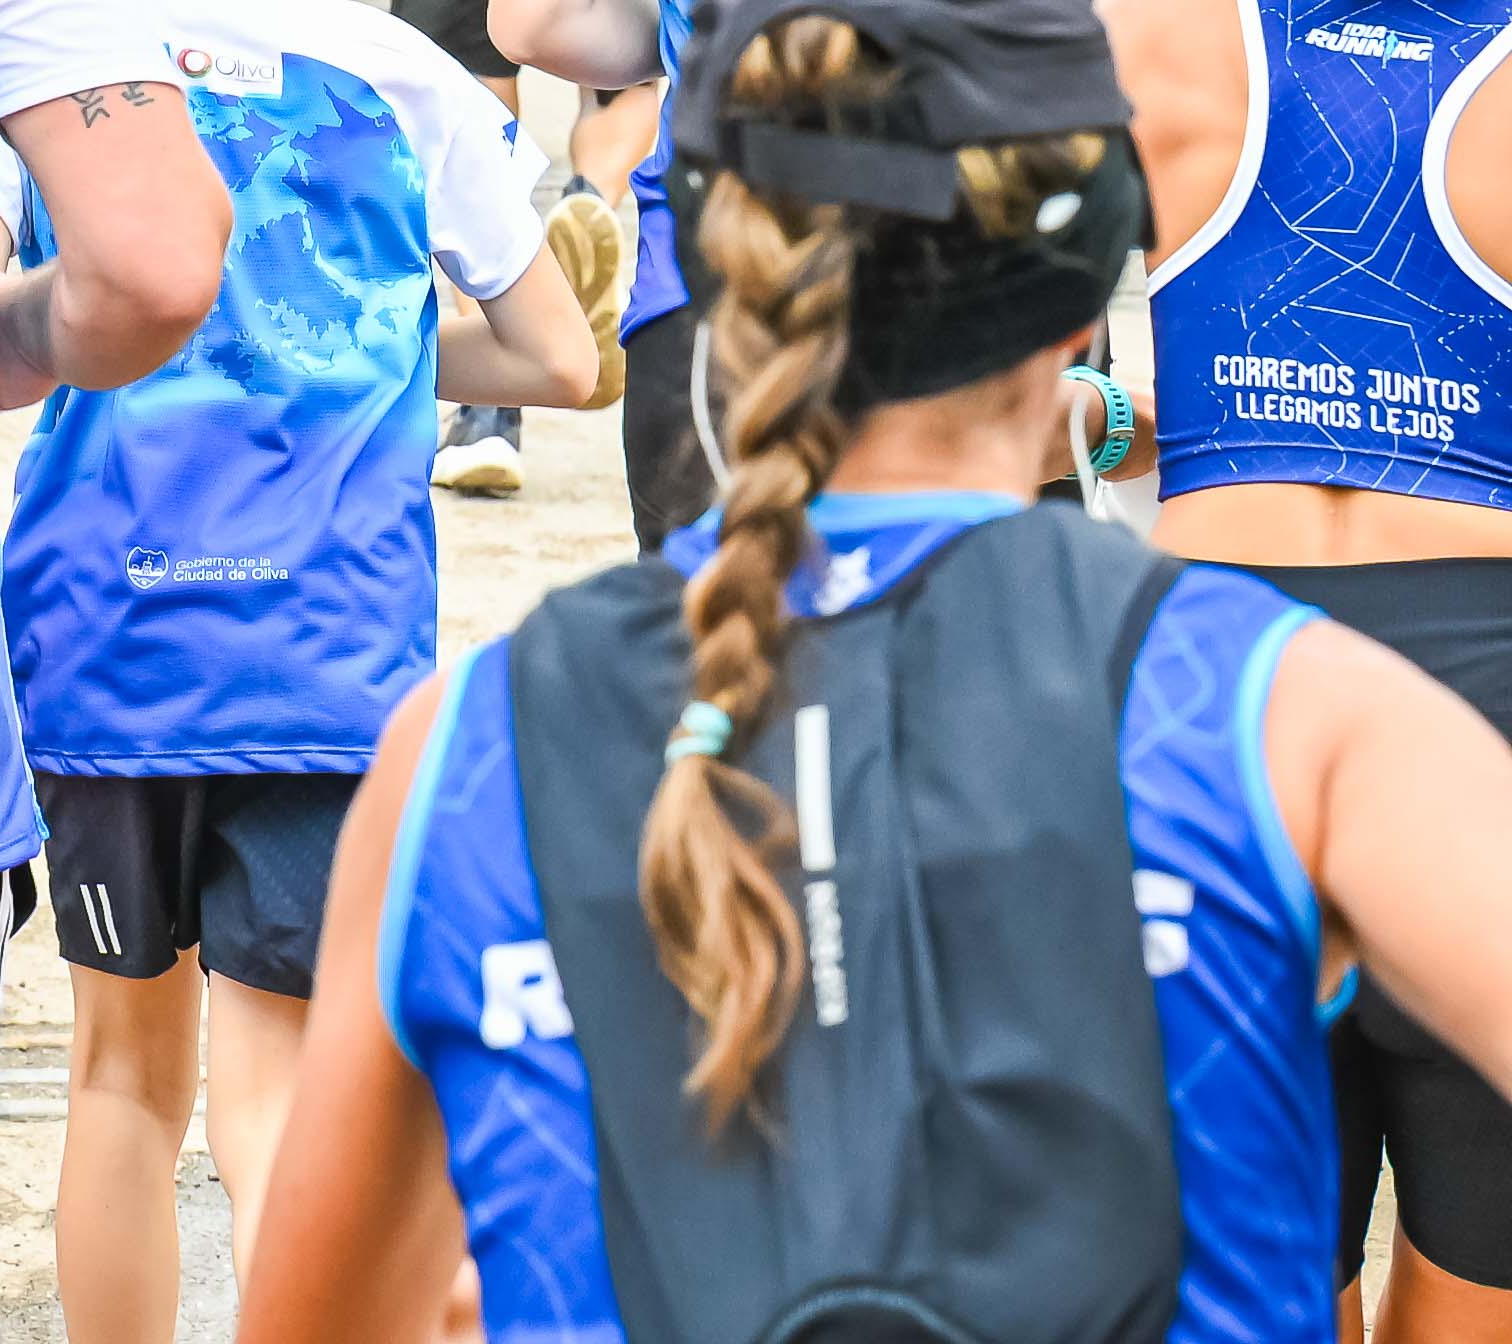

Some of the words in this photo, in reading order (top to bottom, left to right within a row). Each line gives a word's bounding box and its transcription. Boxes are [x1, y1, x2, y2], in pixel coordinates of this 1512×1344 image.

[215, 56, 275, 80] Oliva
[1213, 354, 1356, 396] CORREMOS
[1365, 368, 1481, 414] JUNTOS
[1235, 391, 1362, 430] LLEGAMOS
[1369, 404, 1455, 442] LEJOS
[172, 567, 224, 582] Ciudad
[228, 567, 247, 581] de
[251, 567, 289, 581] Oliva
[175, 556, 235, 571] Gobierno
[238, 557, 256, 568] de
[259, 556, 272, 567] la
